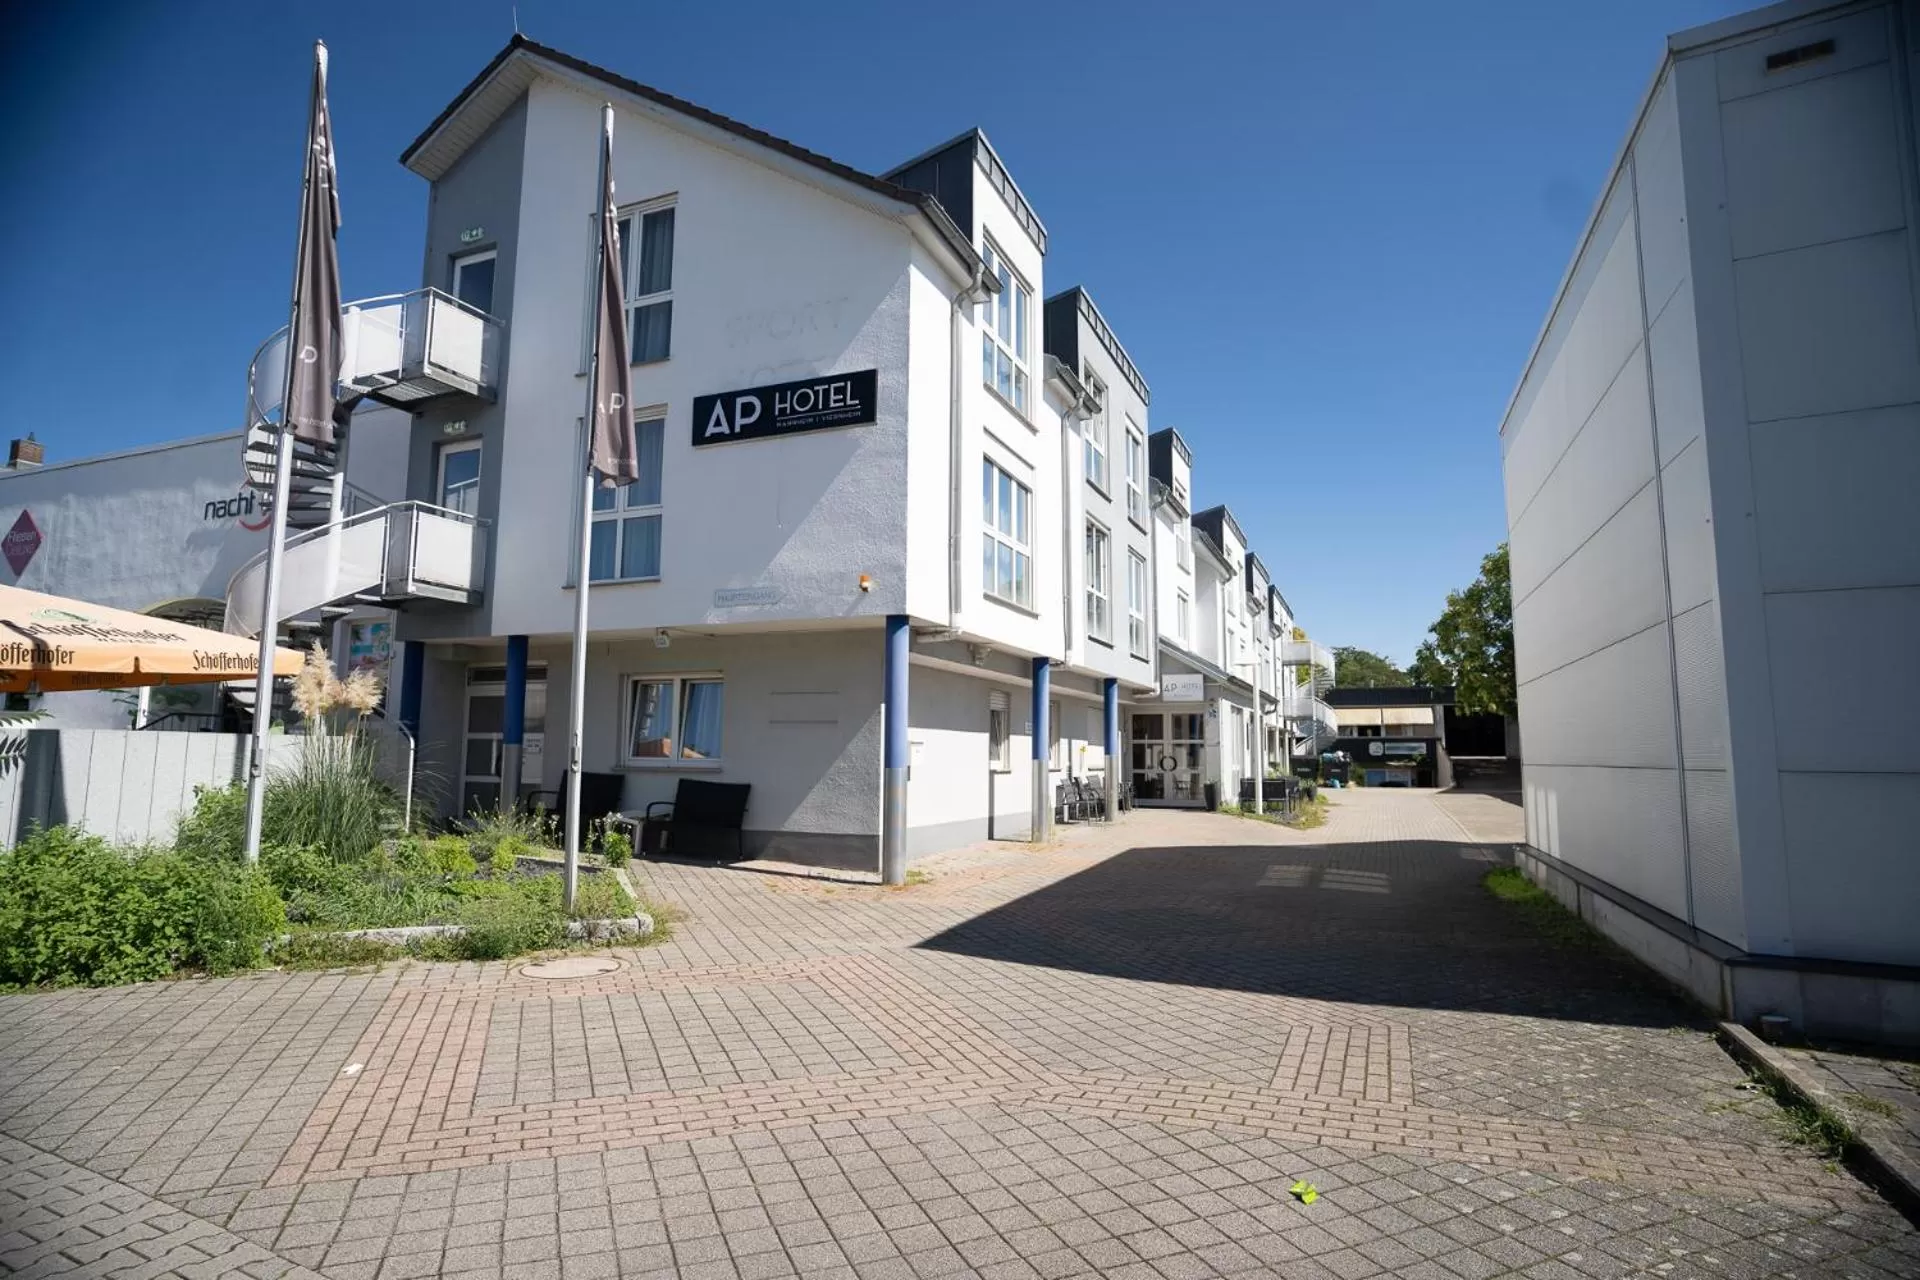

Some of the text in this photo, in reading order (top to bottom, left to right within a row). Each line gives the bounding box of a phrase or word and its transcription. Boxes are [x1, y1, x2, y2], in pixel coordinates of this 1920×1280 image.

[705, 381, 859, 437] AP HOTEL
[204, 490, 256, 520] nacht
[0, 642, 75, 666] öfferhofer
[193, 650, 260, 671] Schöfferhofe
